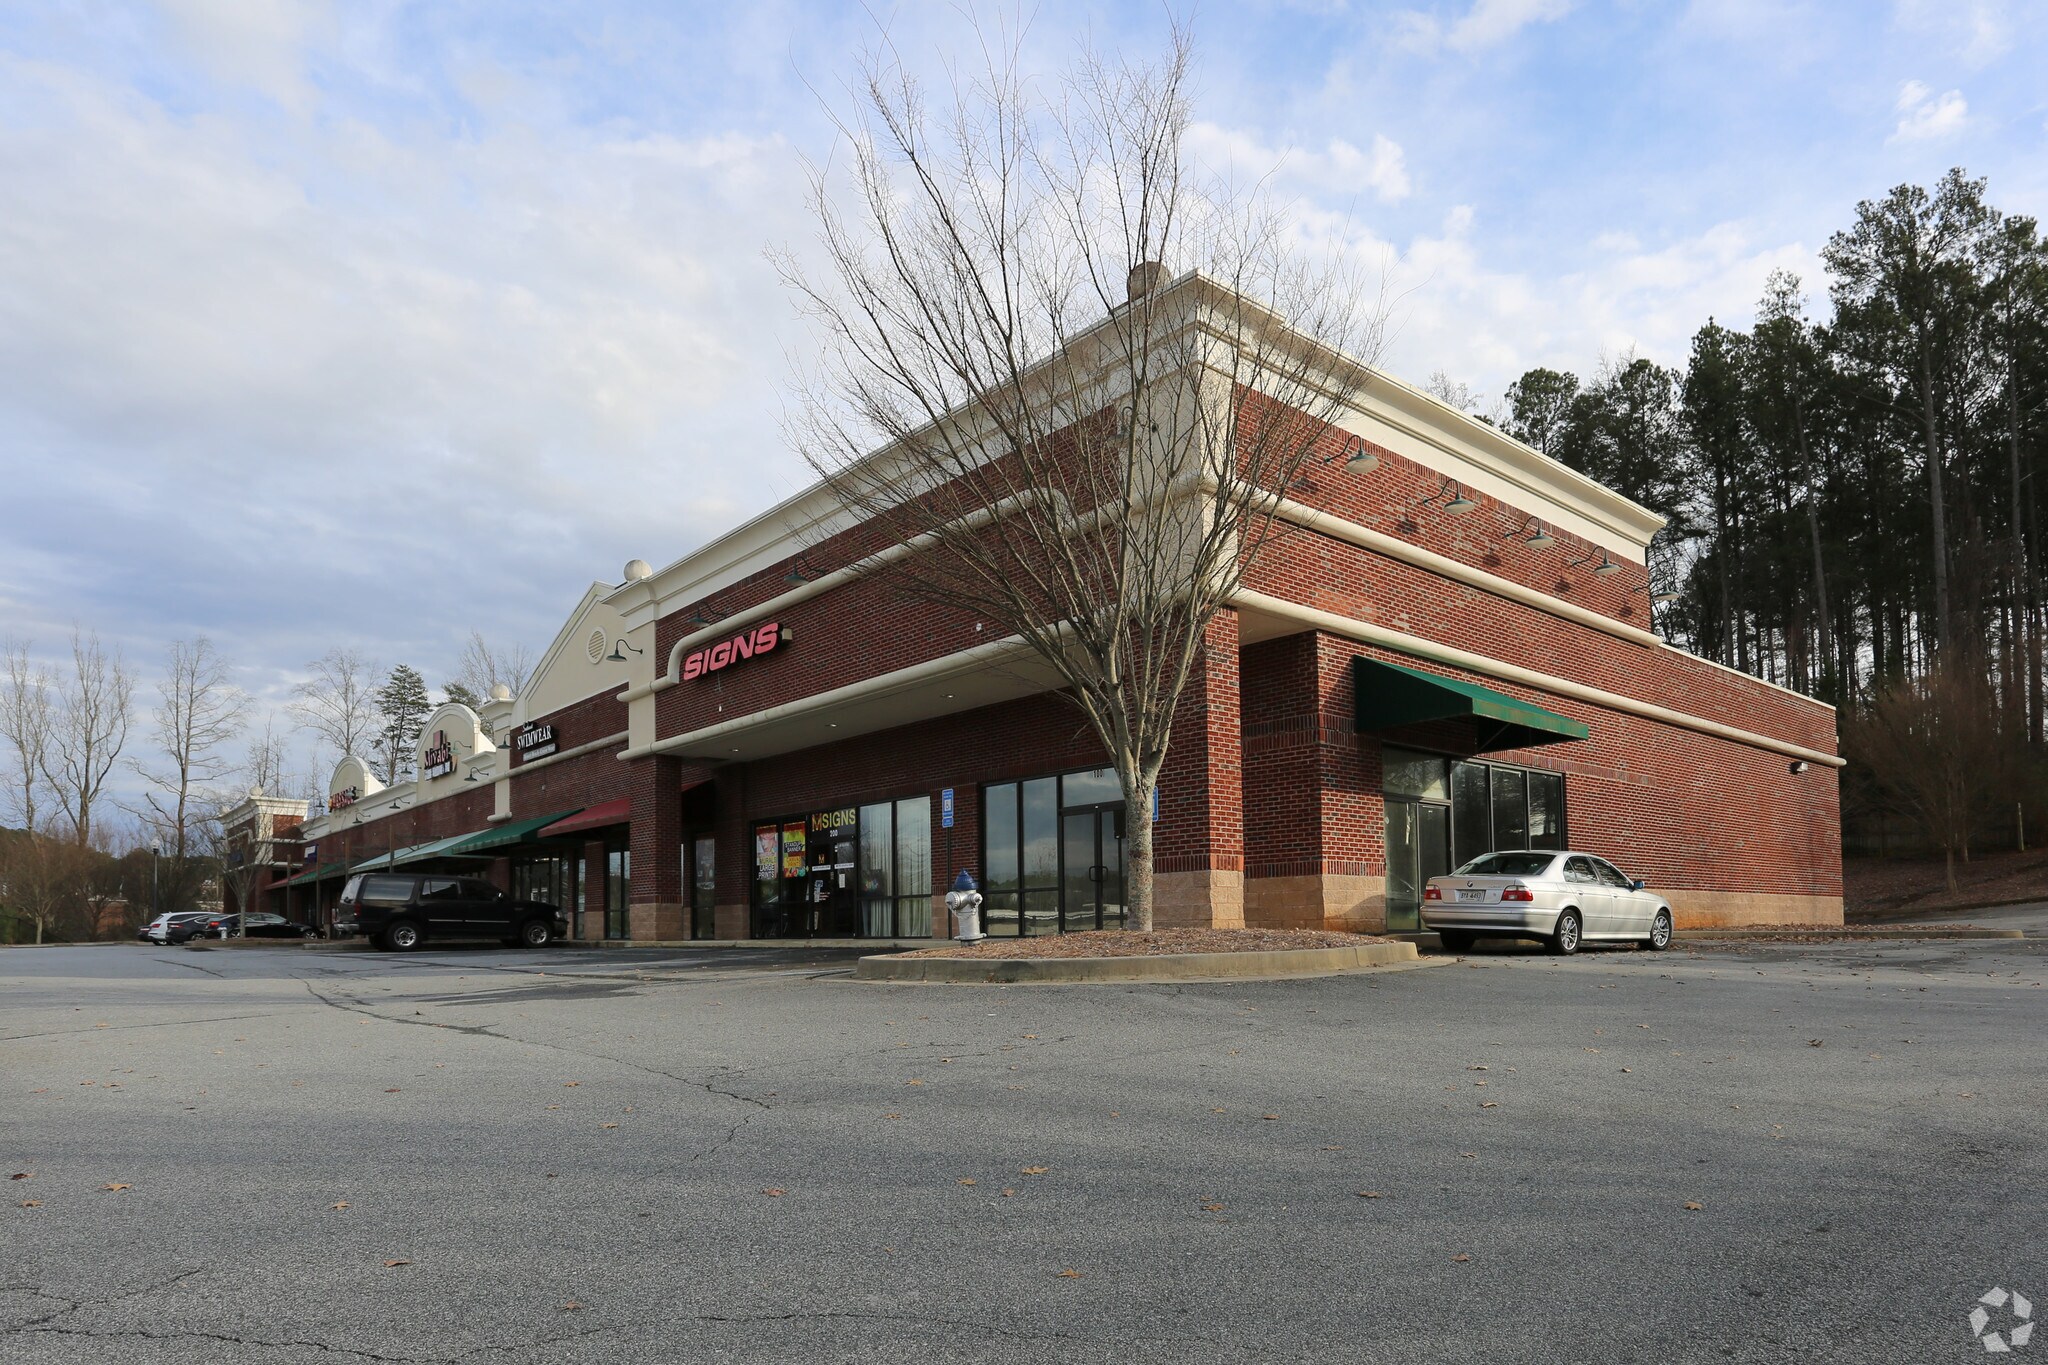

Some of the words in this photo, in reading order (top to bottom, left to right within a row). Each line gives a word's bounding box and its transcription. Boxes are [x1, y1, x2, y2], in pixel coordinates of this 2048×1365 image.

[683, 622, 779, 681] SIGNS
[517, 725, 552, 750] SWIMWEAR
[758, 871, 775, 879] PRINTS
[760, 864, 775, 872] LARGE
